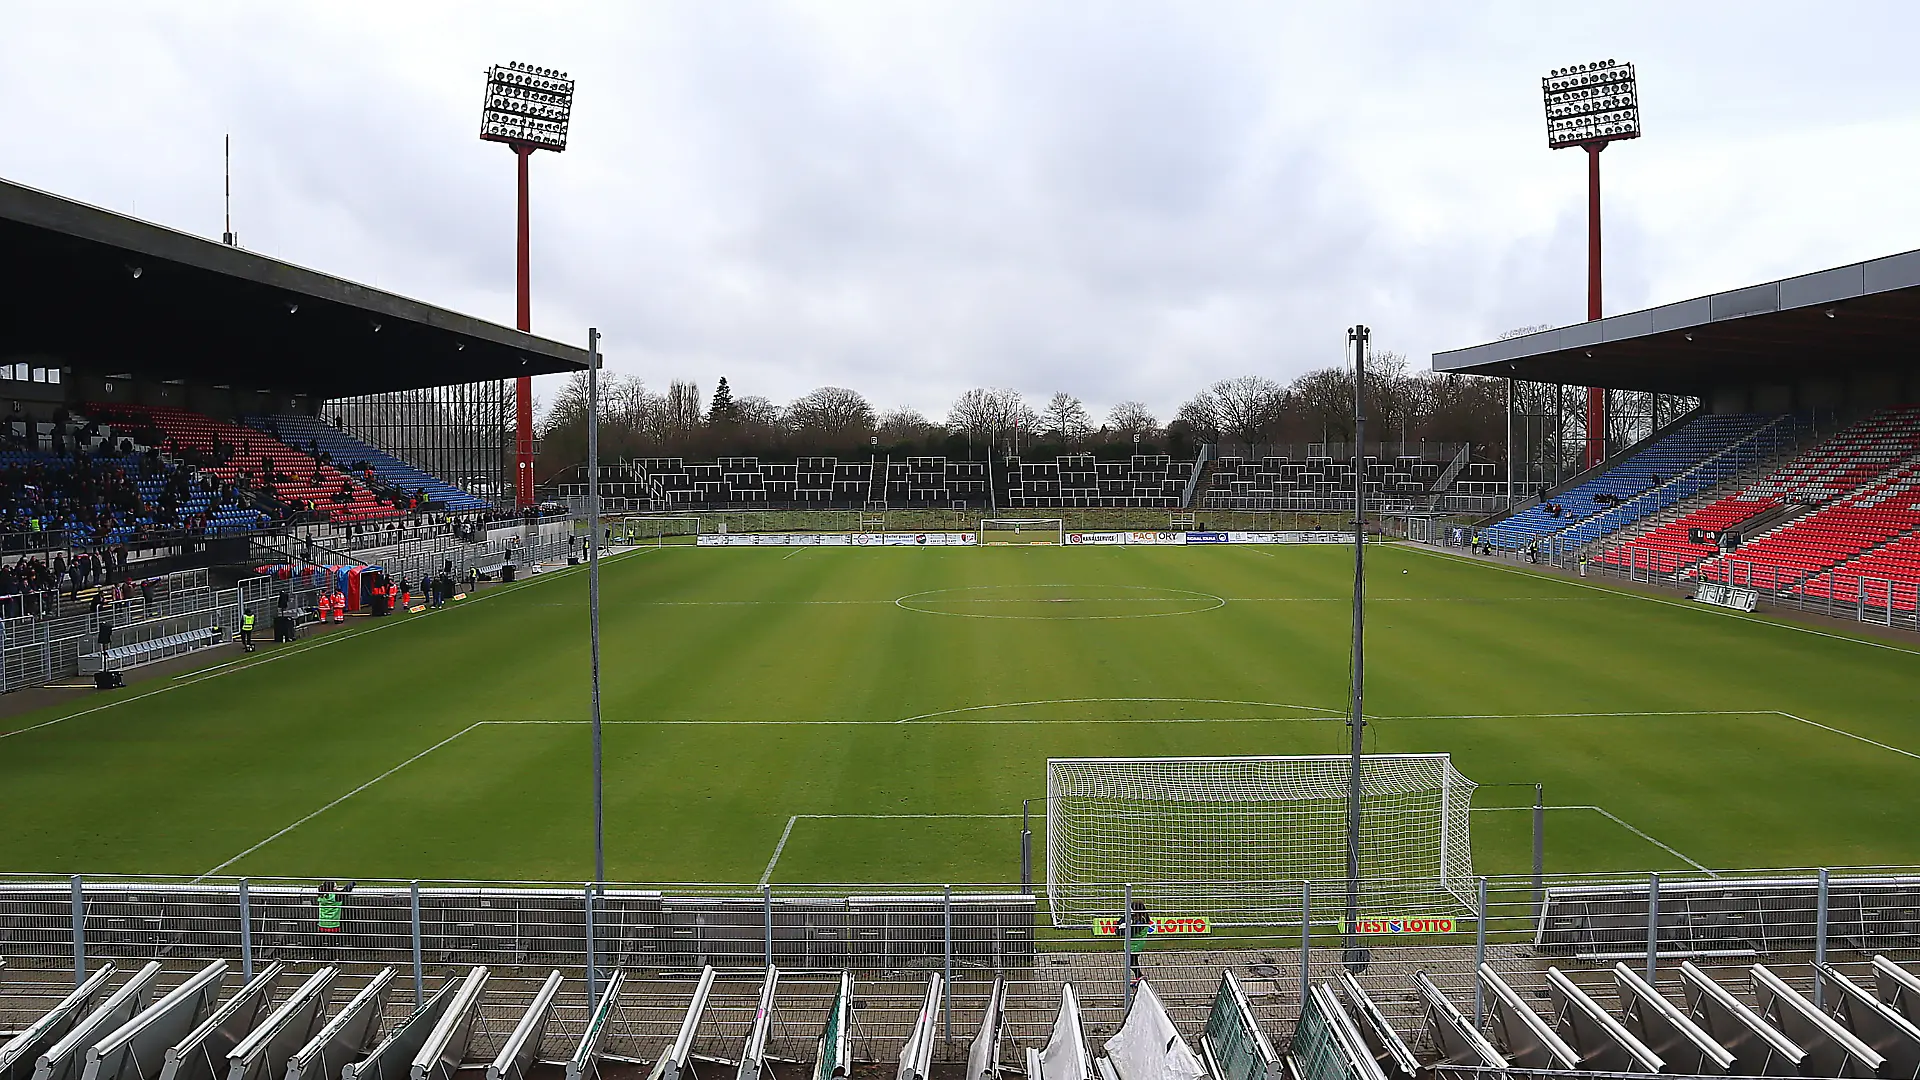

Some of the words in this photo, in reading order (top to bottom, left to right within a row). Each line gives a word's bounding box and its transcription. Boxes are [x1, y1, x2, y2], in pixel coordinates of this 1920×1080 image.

[1133, 531, 1177, 541] FACTORY
[1156, 918, 1206, 933] LOTTO
[1402, 918, 1452, 933] LOTTO
